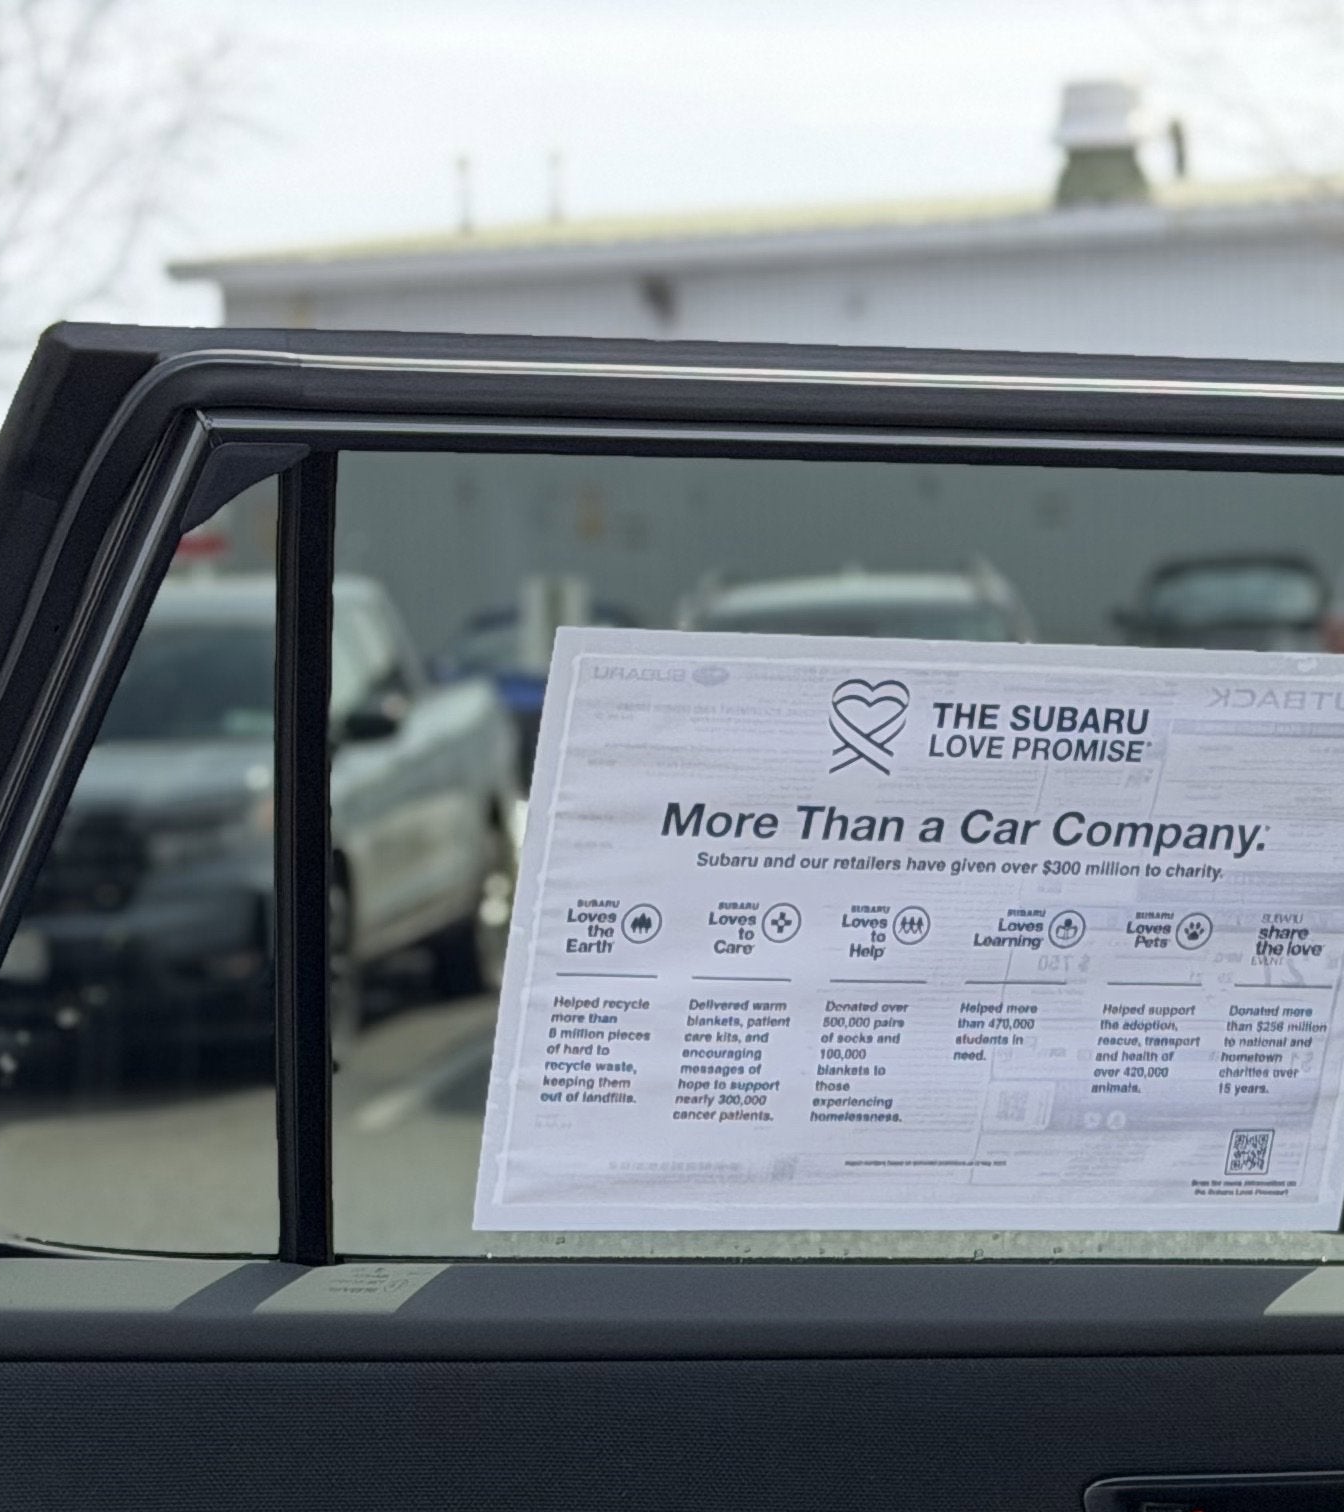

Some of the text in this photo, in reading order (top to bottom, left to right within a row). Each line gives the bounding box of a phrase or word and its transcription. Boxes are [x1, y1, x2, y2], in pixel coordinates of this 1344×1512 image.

[933, 703, 1149, 734] THE SUBARU
[929, 734, 1144, 762] LOVE PROMISE
[662, 803, 1264, 858] More Than a Car Company.
[697, 852, 1223, 882] Subaru and our retailers have given over $300 million to charity.
[567, 908, 616, 923] Loves
[709, 912, 756, 926] Loves
[842, 914, 887, 929] Loves
[588, 924, 614, 937] the
[998, 918, 1043, 932] Loves
[1127, 921, 1171, 934] Loves
[738, 927, 754, 940] to
[871, 930, 886, 942] to
[1259, 925, 1309, 942] share
[566, 938, 614, 953] Earth
[974, 933, 1043, 950] Learning
[1135, 933, 1168, 948] Pets
[714, 940, 754, 955] Care
[850, 943, 885, 960] Help
[1256, 939, 1322, 956] the love
[554, 996, 650, 1012] Helped recycle
[689, 999, 787, 1011] Delivered warm
[825, 1001, 909, 1012] Donated over
[960, 1002, 1038, 1015] Helped more
[1103, 1004, 1195, 1017] Helped support
[1229, 1005, 1313, 1017] Donated more
[551, 1013, 617, 1023] more than
[687, 1015, 790, 1029] blankets, patient
[823, 1017, 904, 1030] 500,000 pairs
[958, 1018, 1035, 1030] than 470,000
[1101, 1019, 1178, 1032] the adoption,
[1227, 1020, 1252, 1031] than
[1288, 1021, 1327, 1032] million
[560, 1028, 604, 1039] million
[608, 1029, 650, 1042] pieces
[684, 1032, 769, 1043] care kits, and
[821, 1032, 900, 1044] of socks and
[956, 1034, 1024, 1045] students in
[1098, 1037, 1200, 1048] rescue, transport
[1224, 1037, 1312, 1047] to national and
[547, 1043, 610, 1055] of hard to
[682, 1048, 762, 1061] encouraging
[821, 1049, 866, 1061] 100,000
[953, 1050, 986, 1061] need.
[1096, 1051, 1175, 1061] and health of
[1221, 1052, 1282, 1062] hometown
[545, 1060, 637, 1074] recycle waste,
[681, 1064, 762, 1077] messages of
[817, 1064, 886, 1076] blankets to
[1094, 1067, 1169, 1079] over 420,000
[1219, 1066, 1299, 1078] charities over
[543, 1075, 631, 1089] keeping them
[678, 1079, 780, 1093] hope to support
[816, 1081, 850, 1091] those
[1091, 1082, 1141, 1093] animals.
[1219, 1083, 1269, 1096] 15 years.
[540, 1091, 636, 1103] out of landfills.
[675, 1094, 767, 1107] nearly 300,000
[813, 1096, 893, 1109] experiencing
[673, 1110, 773, 1123] cancer patients.
[810, 1111, 902, 1122] homelessness.
